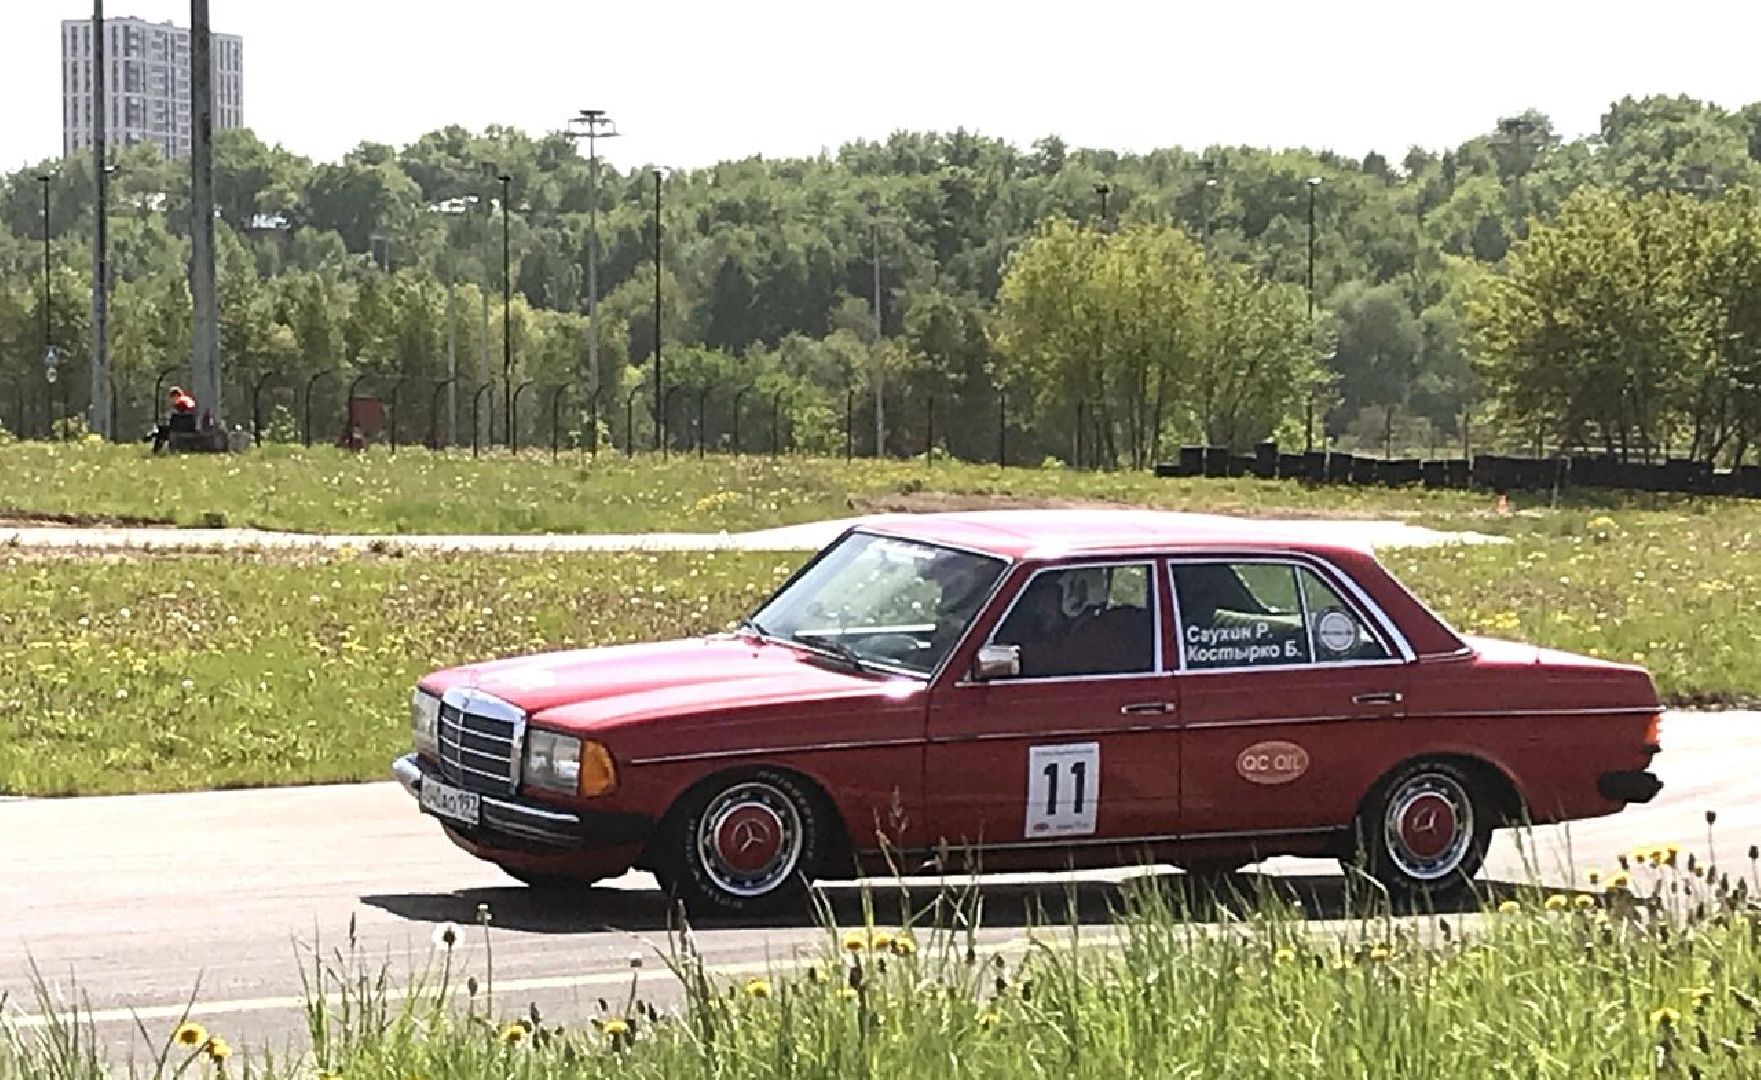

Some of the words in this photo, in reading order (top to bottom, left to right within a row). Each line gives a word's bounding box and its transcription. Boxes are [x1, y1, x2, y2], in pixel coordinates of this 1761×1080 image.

[1187, 644, 1280, 663] Костырко
[1285, 640, 1303, 657] Б.
[1044, 761, 1086, 815] 11
